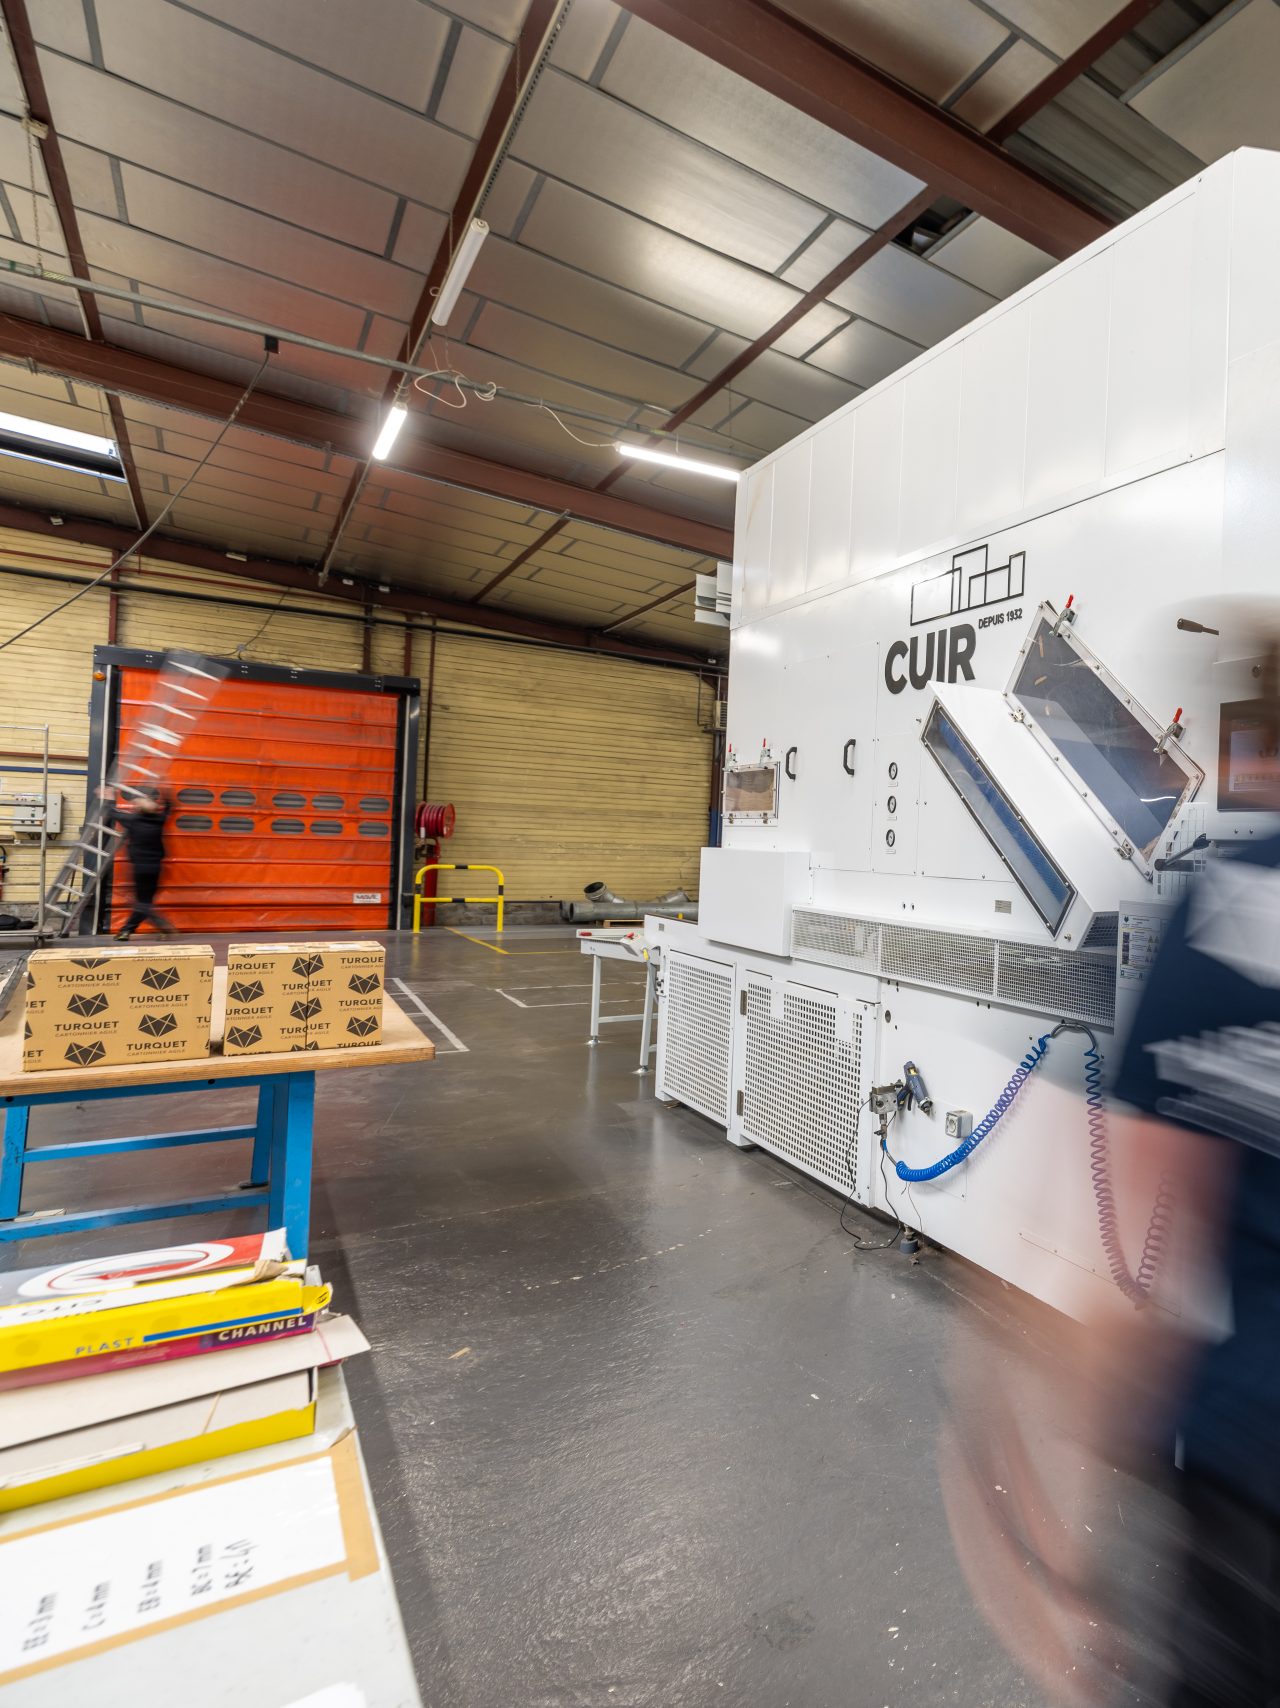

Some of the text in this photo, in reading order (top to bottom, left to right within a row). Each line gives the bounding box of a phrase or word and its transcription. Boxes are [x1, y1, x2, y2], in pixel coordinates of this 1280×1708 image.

[978, 607, 1023, 630] DEPUIS 1932
[884, 623, 977, 695] CUIR
[57, 973, 122, 983] TURQUET
[128, 994, 190, 1004] TURQUET
[54, 1021, 119, 1032] TURQUET
[126, 1040, 188, 1051] TURQUET
[218, 1316, 307, 1341] CHANNEL
[75, 1337, 134, 1355] PLAST
